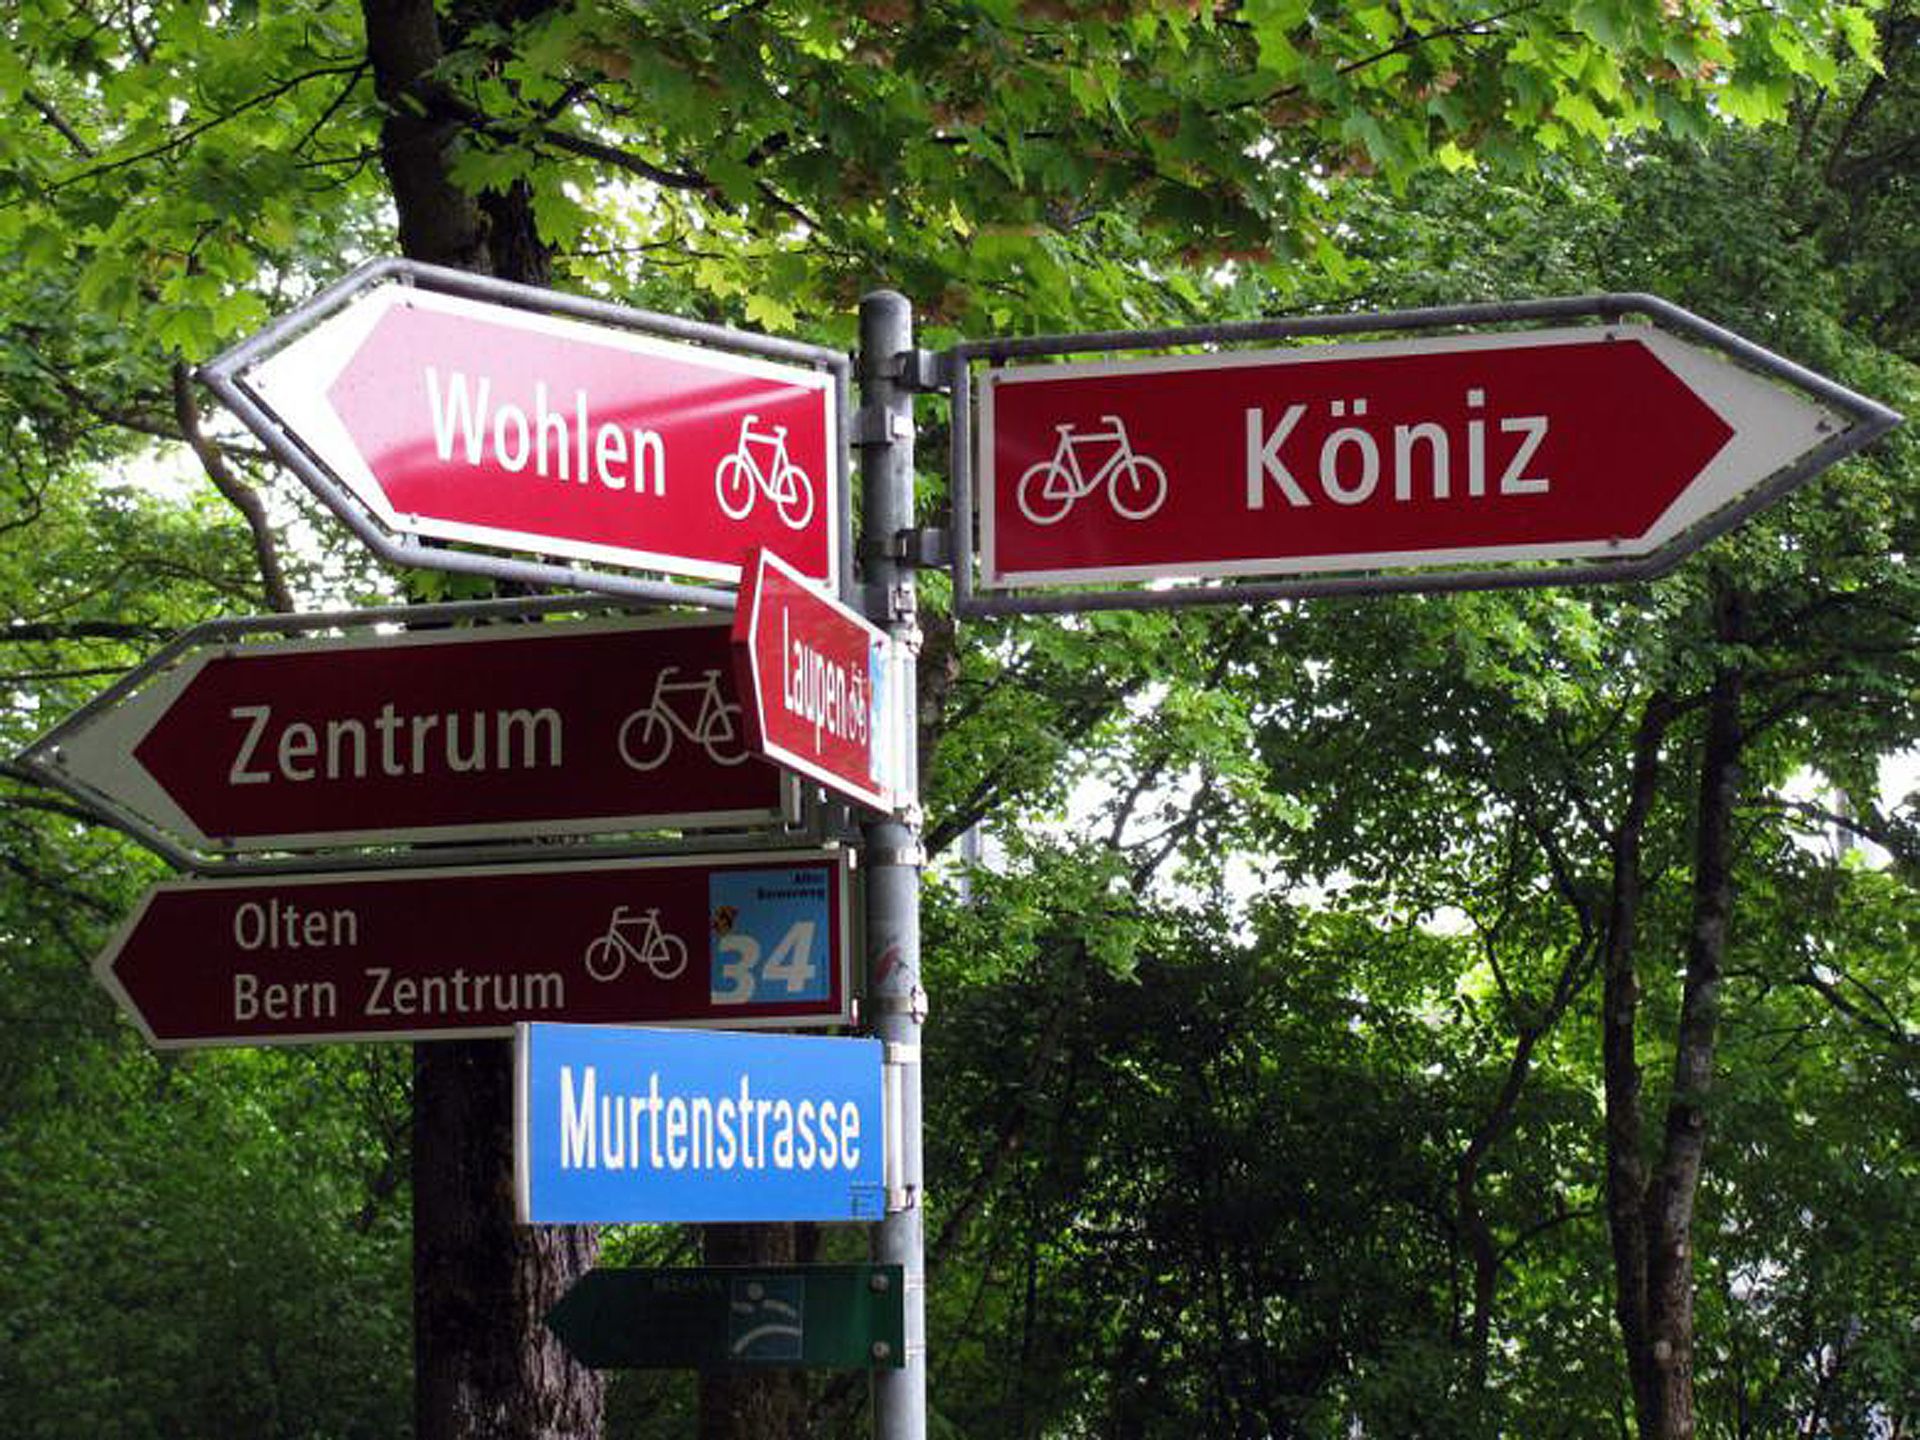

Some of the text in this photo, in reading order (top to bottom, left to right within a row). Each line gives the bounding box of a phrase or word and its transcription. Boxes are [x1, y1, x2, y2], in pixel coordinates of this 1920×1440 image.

[426, 366, 666, 496] Wohlen
[1246, 389, 1550, 510] Köniz
[783, 605, 847, 755] Laupen
[229, 702, 563, 785] Zentrum
[234, 899, 358, 950] Olten
[710, 921, 817, 1005] 34
[234, 967, 566, 1021] Bern Zentrum
[559, 1065, 861, 1170] Murtenstrasse
